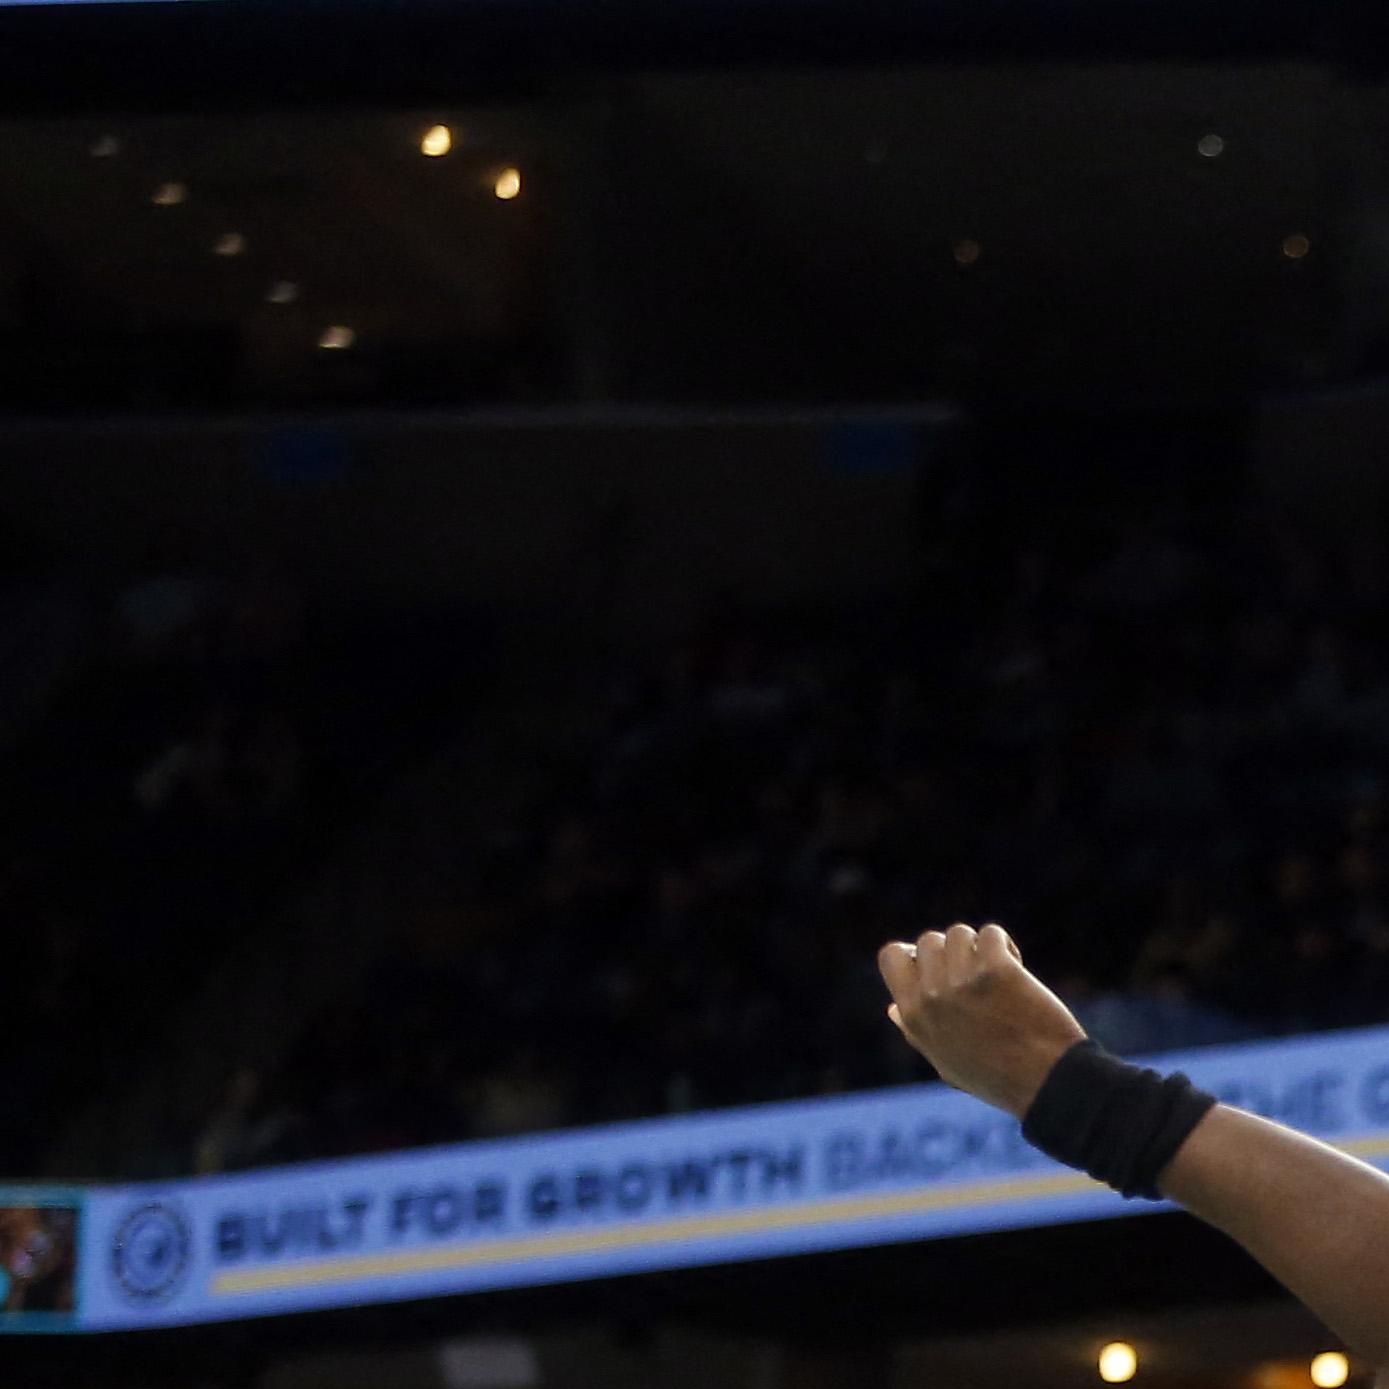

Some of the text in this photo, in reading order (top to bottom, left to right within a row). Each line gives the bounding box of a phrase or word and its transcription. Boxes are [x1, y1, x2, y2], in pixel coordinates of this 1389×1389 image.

[214, 1202, 368, 1264] BUILT
[396, 1180, 512, 1243] FOR
[531, 1150, 798, 1222] GROWTH
